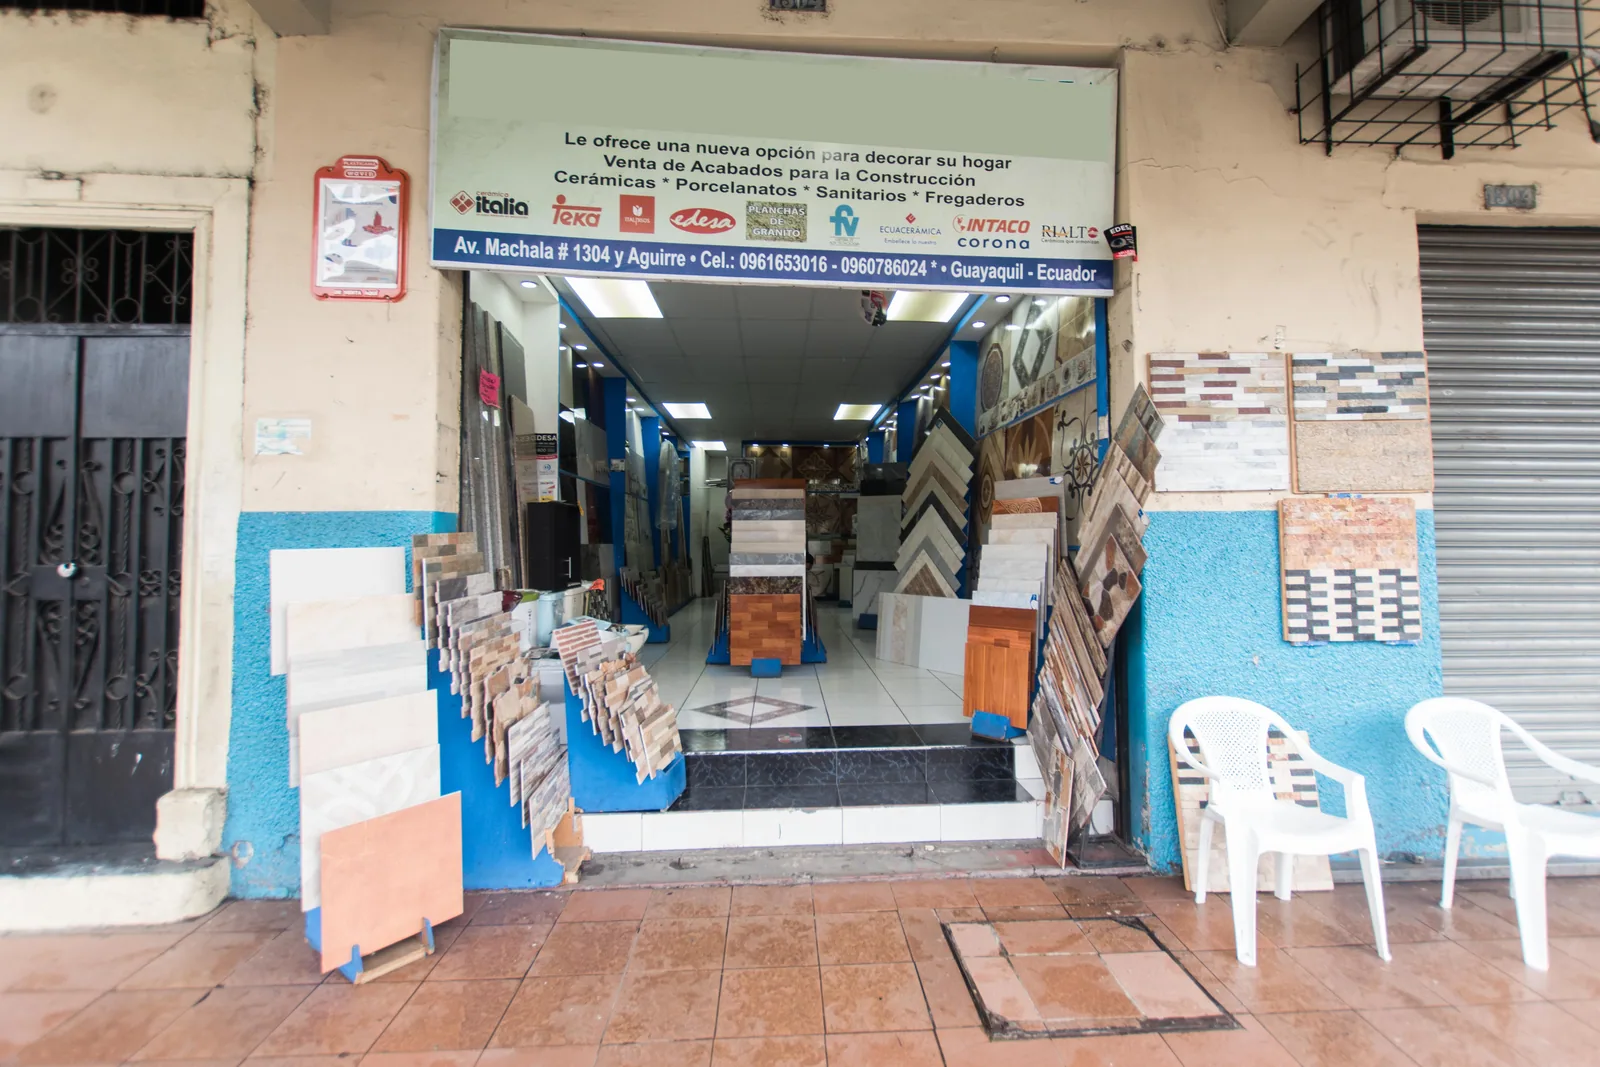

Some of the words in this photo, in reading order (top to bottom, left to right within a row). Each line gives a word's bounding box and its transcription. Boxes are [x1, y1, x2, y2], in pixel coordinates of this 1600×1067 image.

[566, 132, 586, 145] Le
[593, 135, 650, 150] ofrece
[657, 140, 690, 153] una
[697, 144, 749, 156] nueva
[756, 147, 815, 165] opción
[823, 152, 859, 163] para
[866, 151, 931, 165] decorar
[937, 157, 956, 166] su
[963, 155, 1011, 171] hogar
[604, 155, 656, 169] Venta
[663, 159, 685, 171] de
[691, 161, 783, 177] Acabados
[790, 169, 828, 180] para
[836, 169, 849, 180] la
[857, 170, 975, 186] Construcción
[554, 171, 655, 188] Cerámicas
[677, 178, 796, 196] Porcelanatos
[817, 186, 906, 202] Sanitarios
[926, 191, 1024, 207] Fregaderos
[476, 195, 528, 215] italia
[748, 205, 806, 216] PLANCHAS
[669, 208, 735, 229] edesa
[770, 217, 785, 226] DE
[752, 227, 801, 238] GRANITO
[880, 226, 941, 235] ECUACERÁMICA
[967, 219, 1030, 233] INTACO
[1043, 225, 1098, 238] RIALTO
[958, 238, 1029, 249] corona
[454, 236, 479, 254] Av.
[486, 238, 553, 259] Machala
[558, 243, 568, 260] #
[574, 244, 610, 263] 1304
[614, 251, 624, 268] y
[628, 247, 686, 269] Aguirre
[701, 251, 734, 268] Cel.:
[740, 253, 827, 272] 0961653016
[841, 257, 927, 276] 0960786024
[951, 261, 1023, 283] Guayaquil
[1037, 264, 1096, 281] Ecuador
